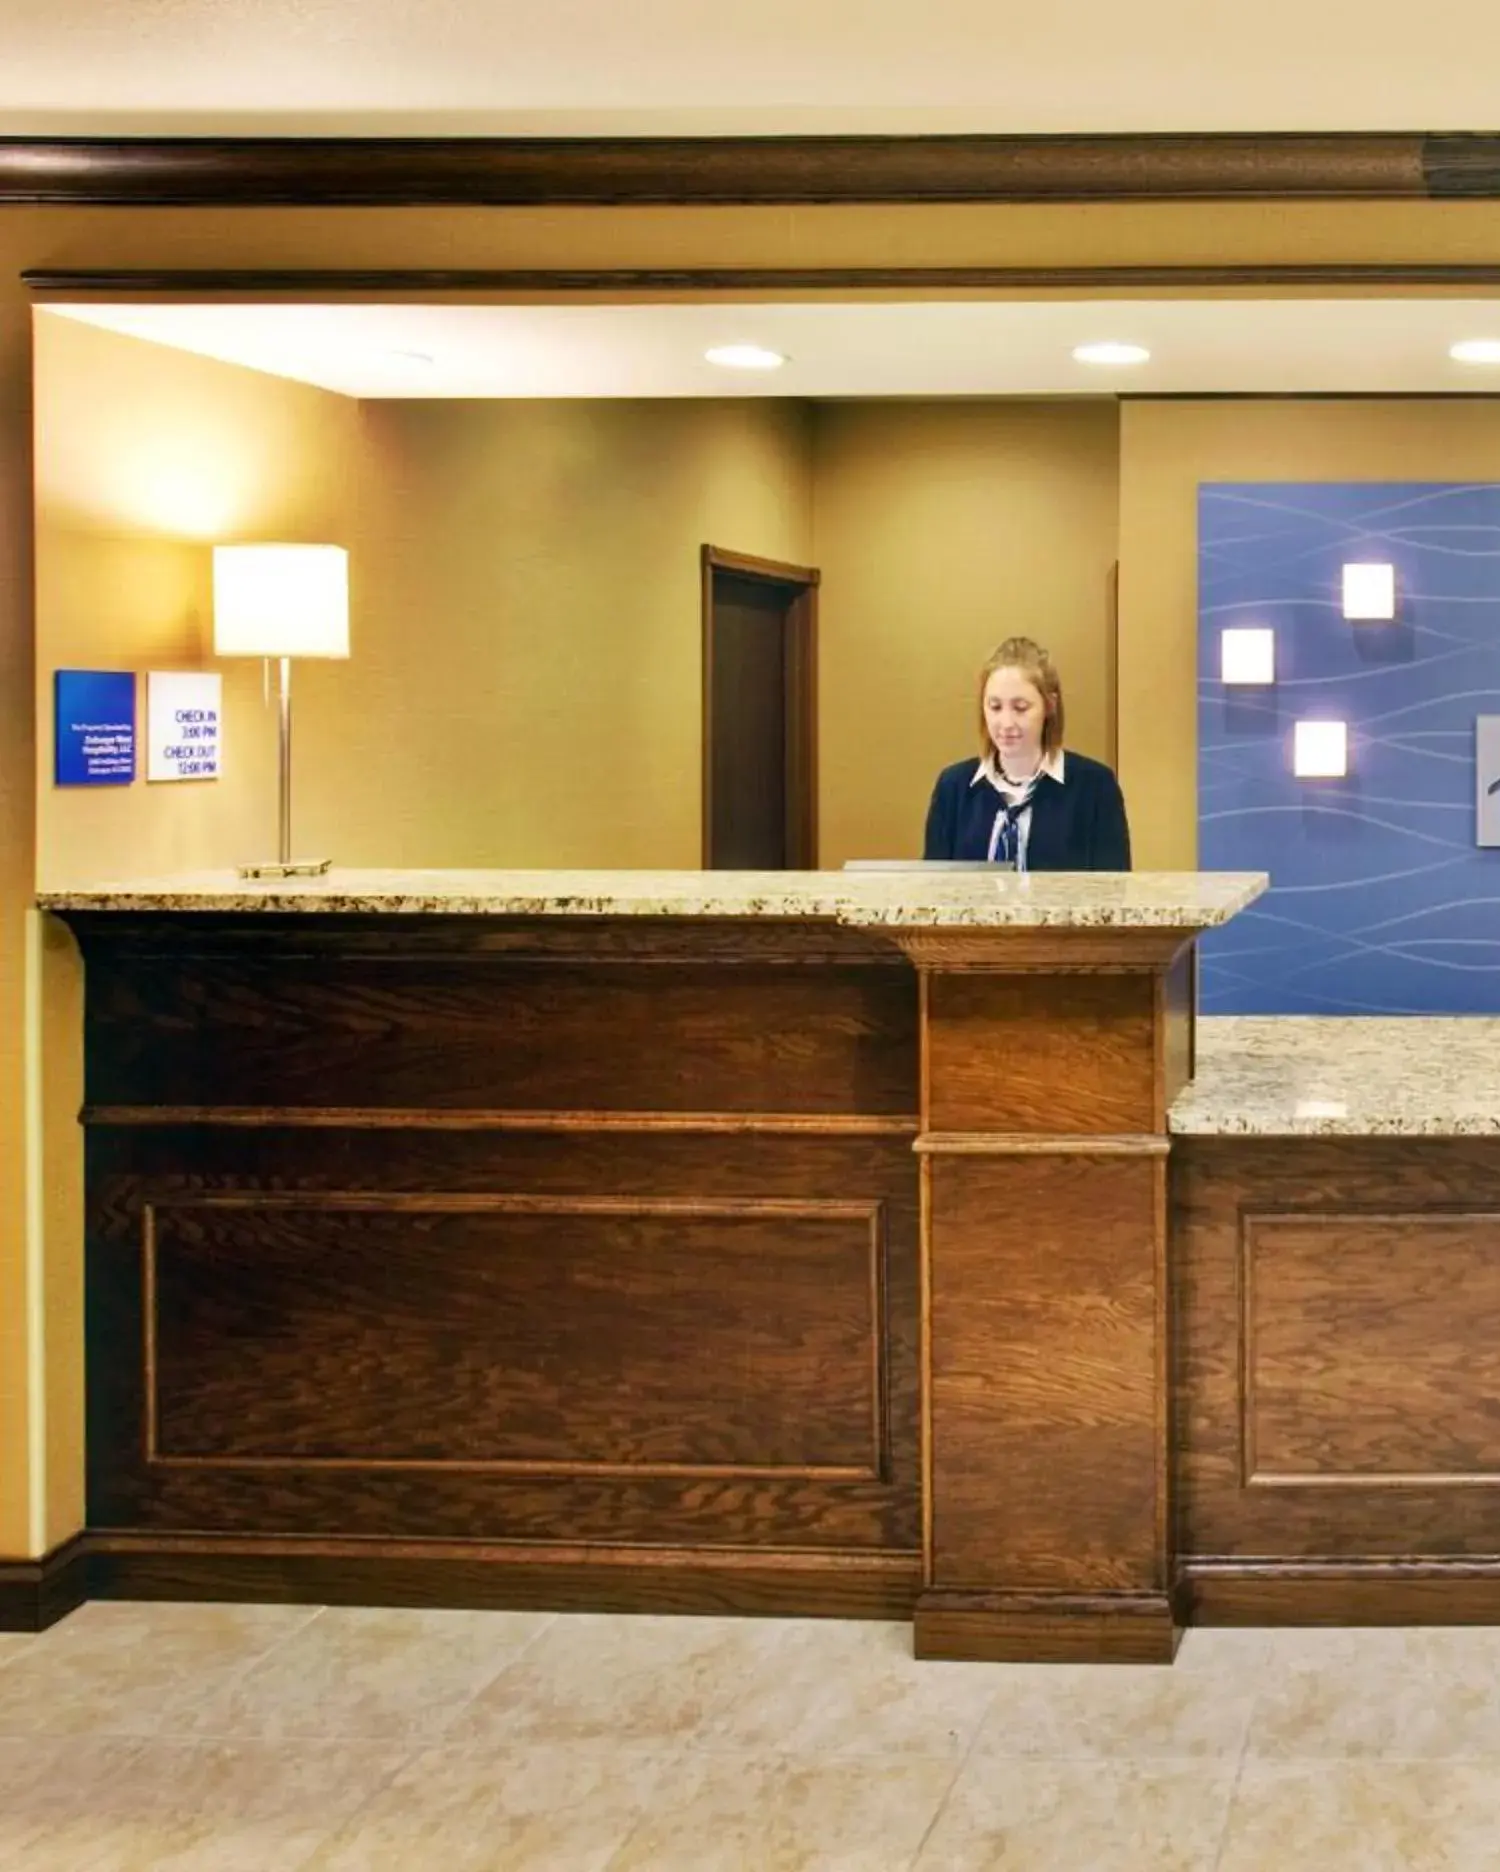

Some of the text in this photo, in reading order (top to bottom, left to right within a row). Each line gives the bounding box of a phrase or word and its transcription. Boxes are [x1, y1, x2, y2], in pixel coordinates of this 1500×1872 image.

[175, 709, 217, 723] CHECK IN
[203, 725, 217, 738] PM
[163, 744, 216, 759] CHECK OUT
[203, 761, 217, 773] PM
